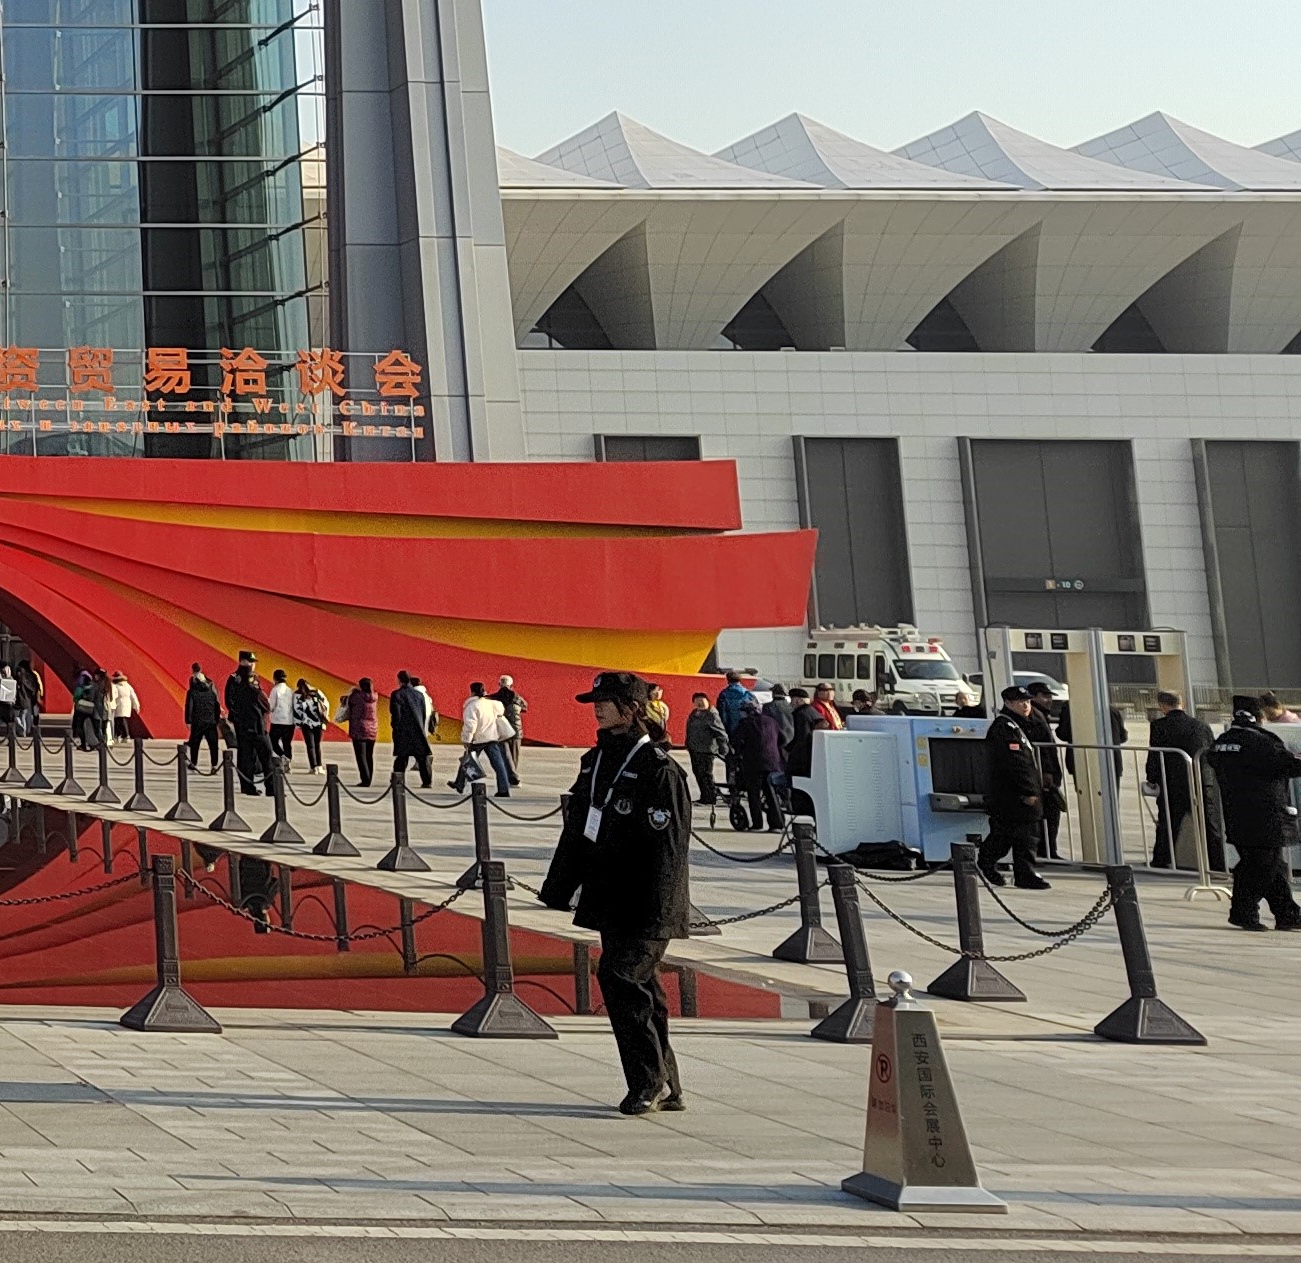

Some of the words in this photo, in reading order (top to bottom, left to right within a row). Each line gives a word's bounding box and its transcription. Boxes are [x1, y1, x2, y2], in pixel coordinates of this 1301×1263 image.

[103, 396, 165, 412] East
[185, 397, 233, 413] and
[252, 397, 320, 414] West
[339, 398, 425, 417] China
[911, 1033, 946, 1168] 西安国际会展中心
